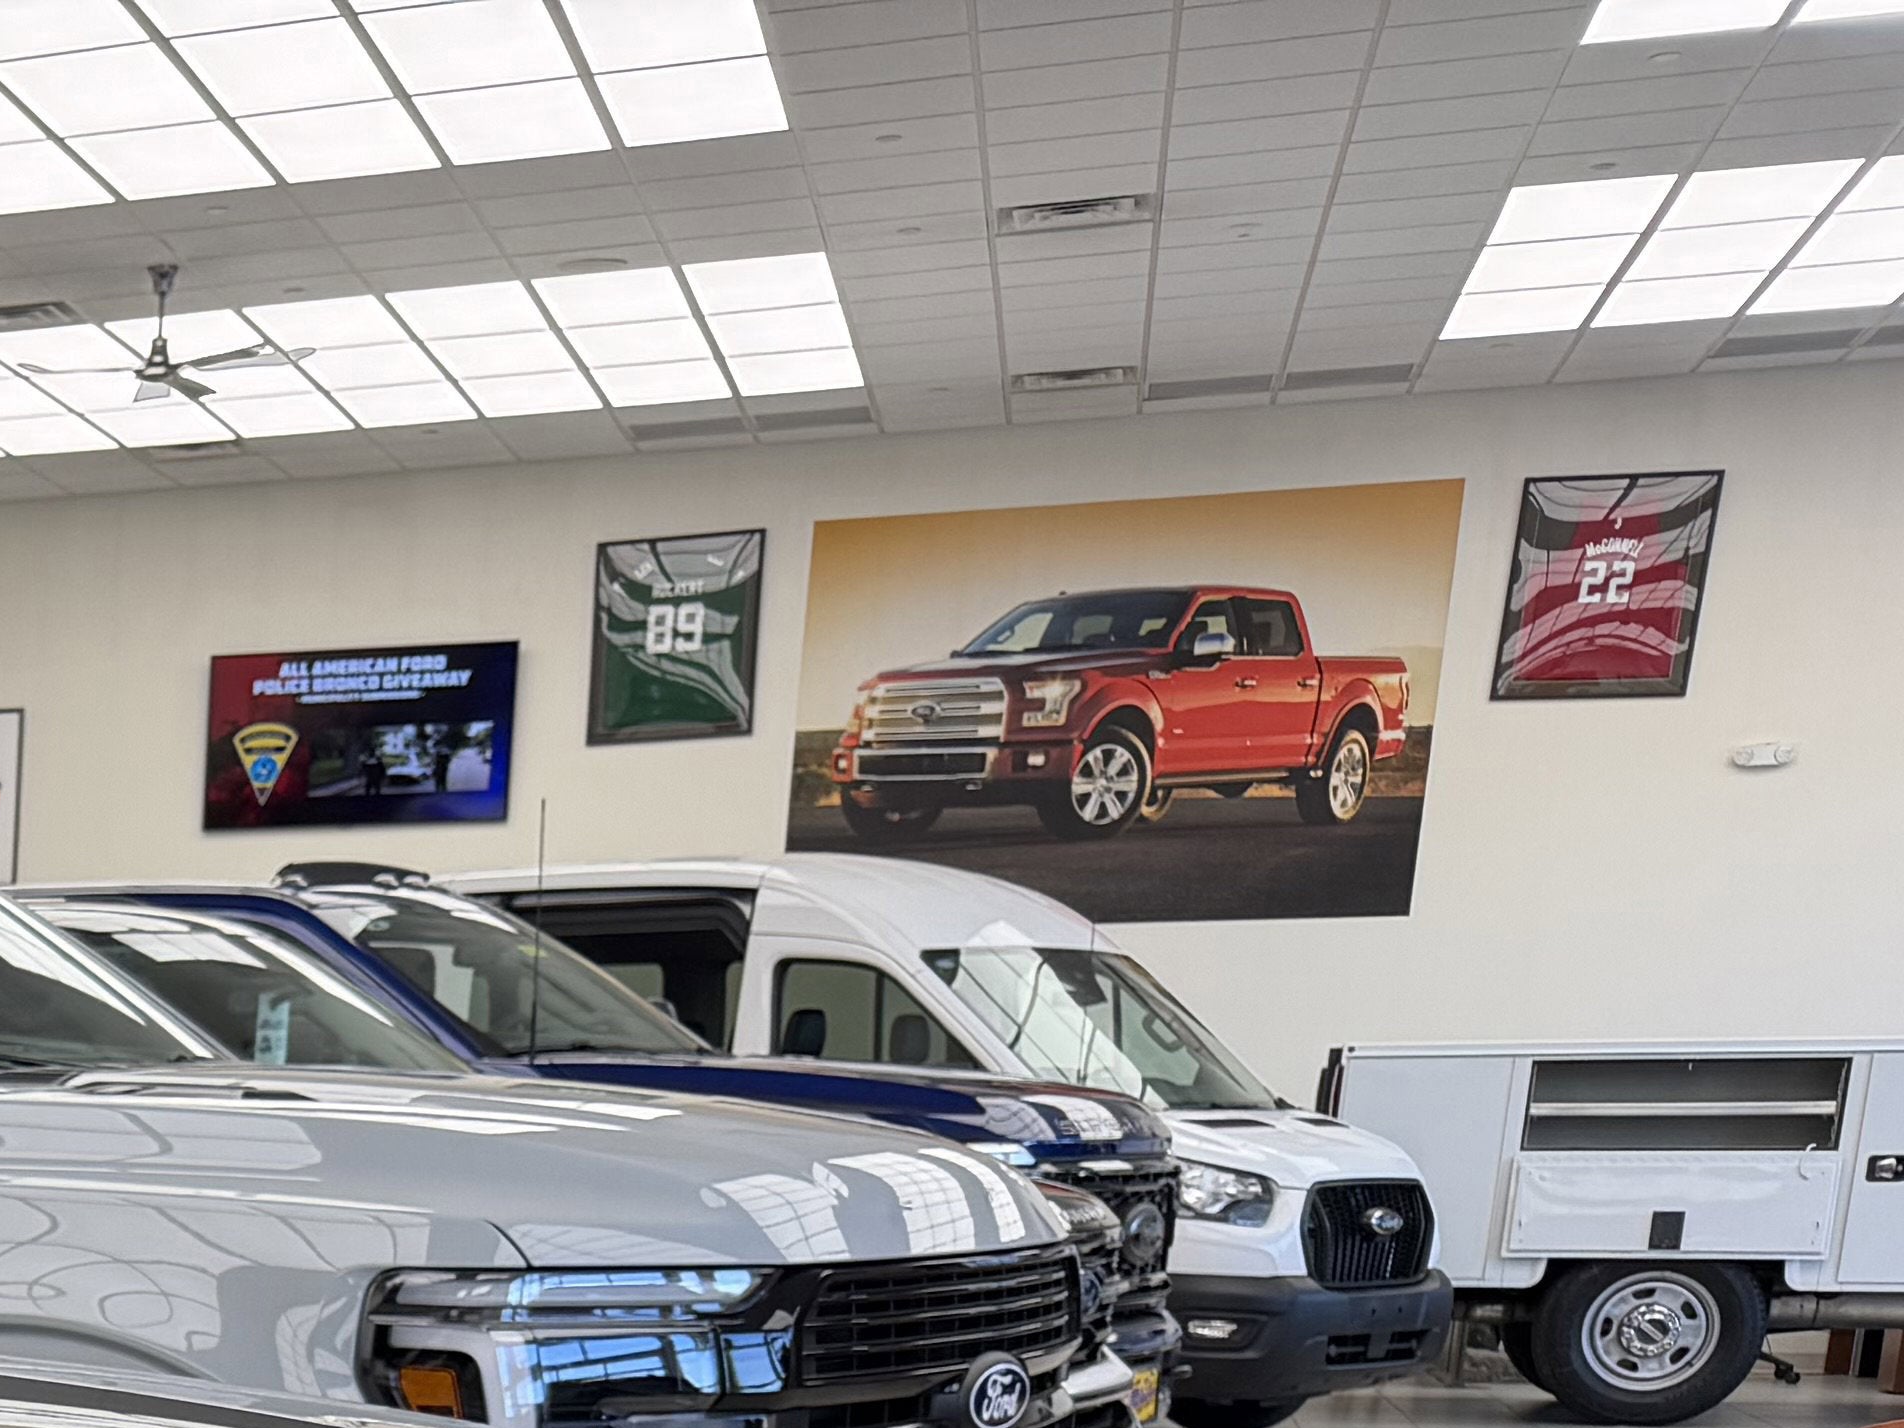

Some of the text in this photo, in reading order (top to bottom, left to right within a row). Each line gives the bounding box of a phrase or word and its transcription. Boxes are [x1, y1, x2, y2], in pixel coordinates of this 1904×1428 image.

[1578, 560, 1637, 604] 22
[645, 601, 706, 655] 89
[981, 1373, 1022, 1422] Ford
